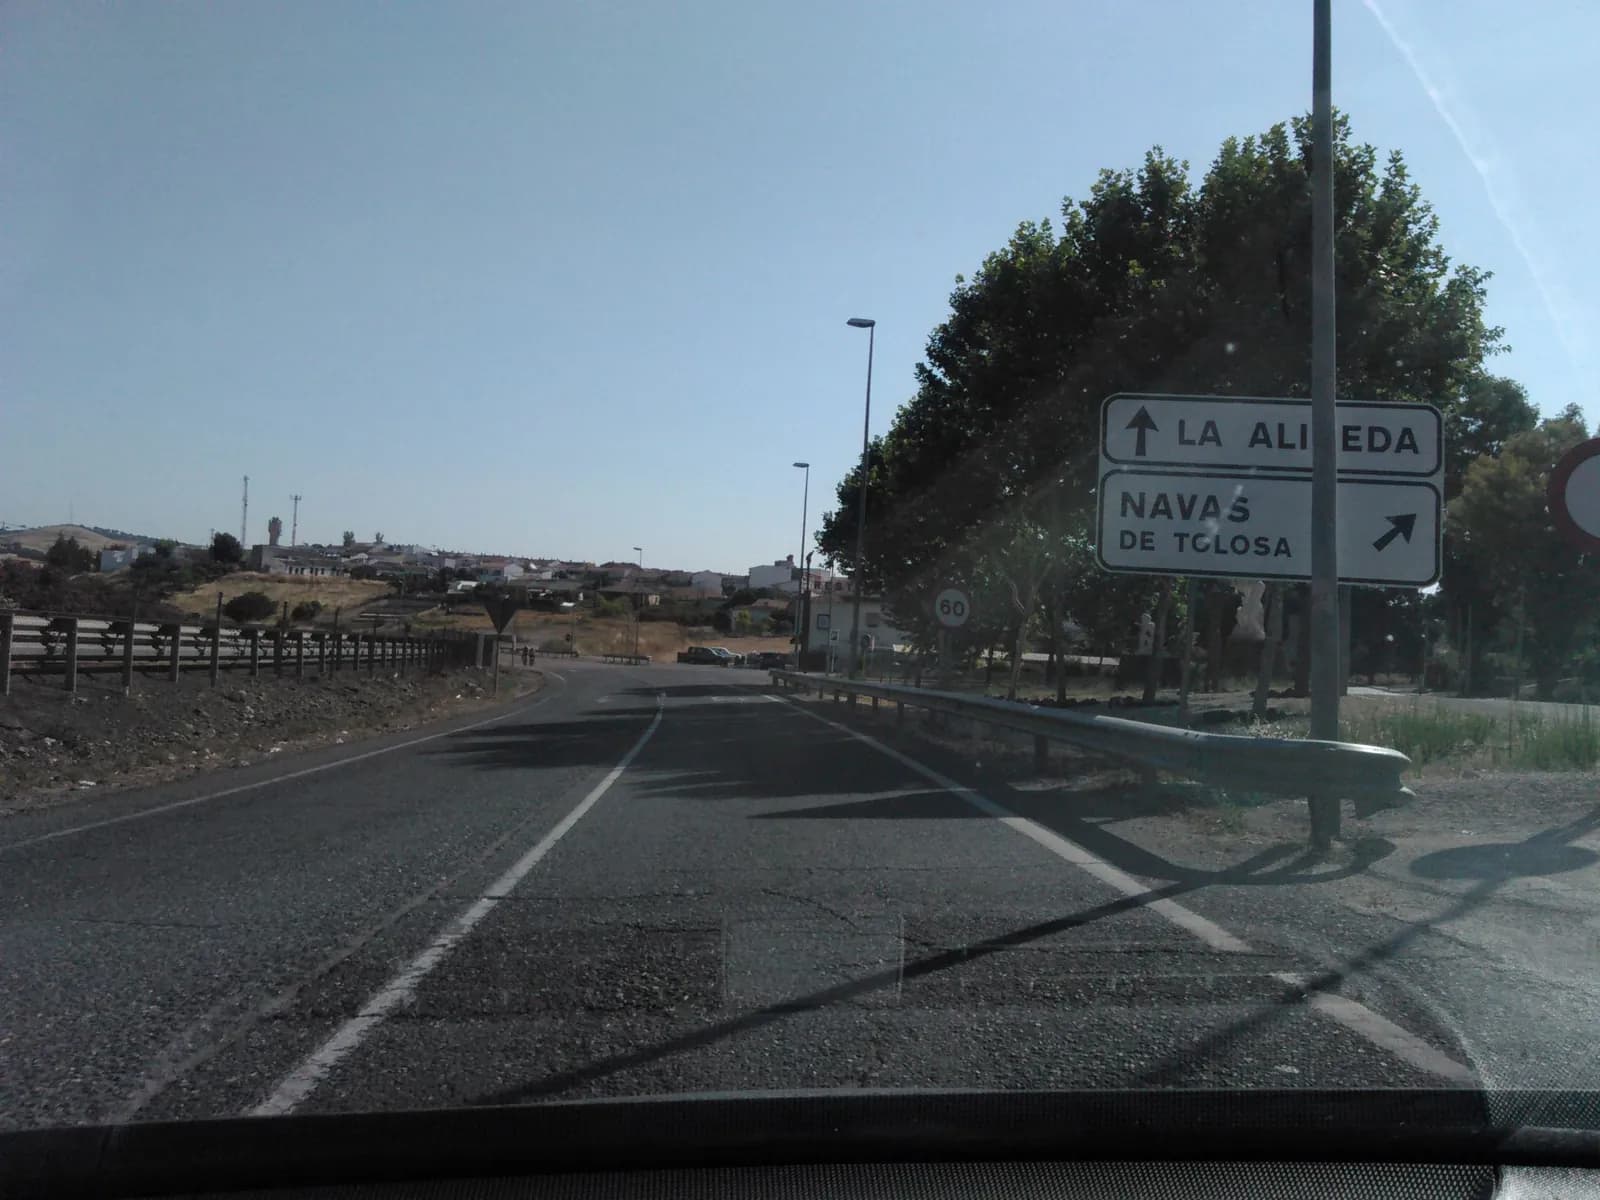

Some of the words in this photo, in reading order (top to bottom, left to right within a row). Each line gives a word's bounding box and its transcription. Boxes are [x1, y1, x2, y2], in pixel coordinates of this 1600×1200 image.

[1178, 419, 1223, 447] LA
[1248, 422, 1419, 454] ALIEDA
[1120, 491, 1250, 523] NAVAS
[1119, 529, 1155, 551] DE
[1173, 532, 1292, 558] TOLOSA
[940, 599, 965, 617] 60
